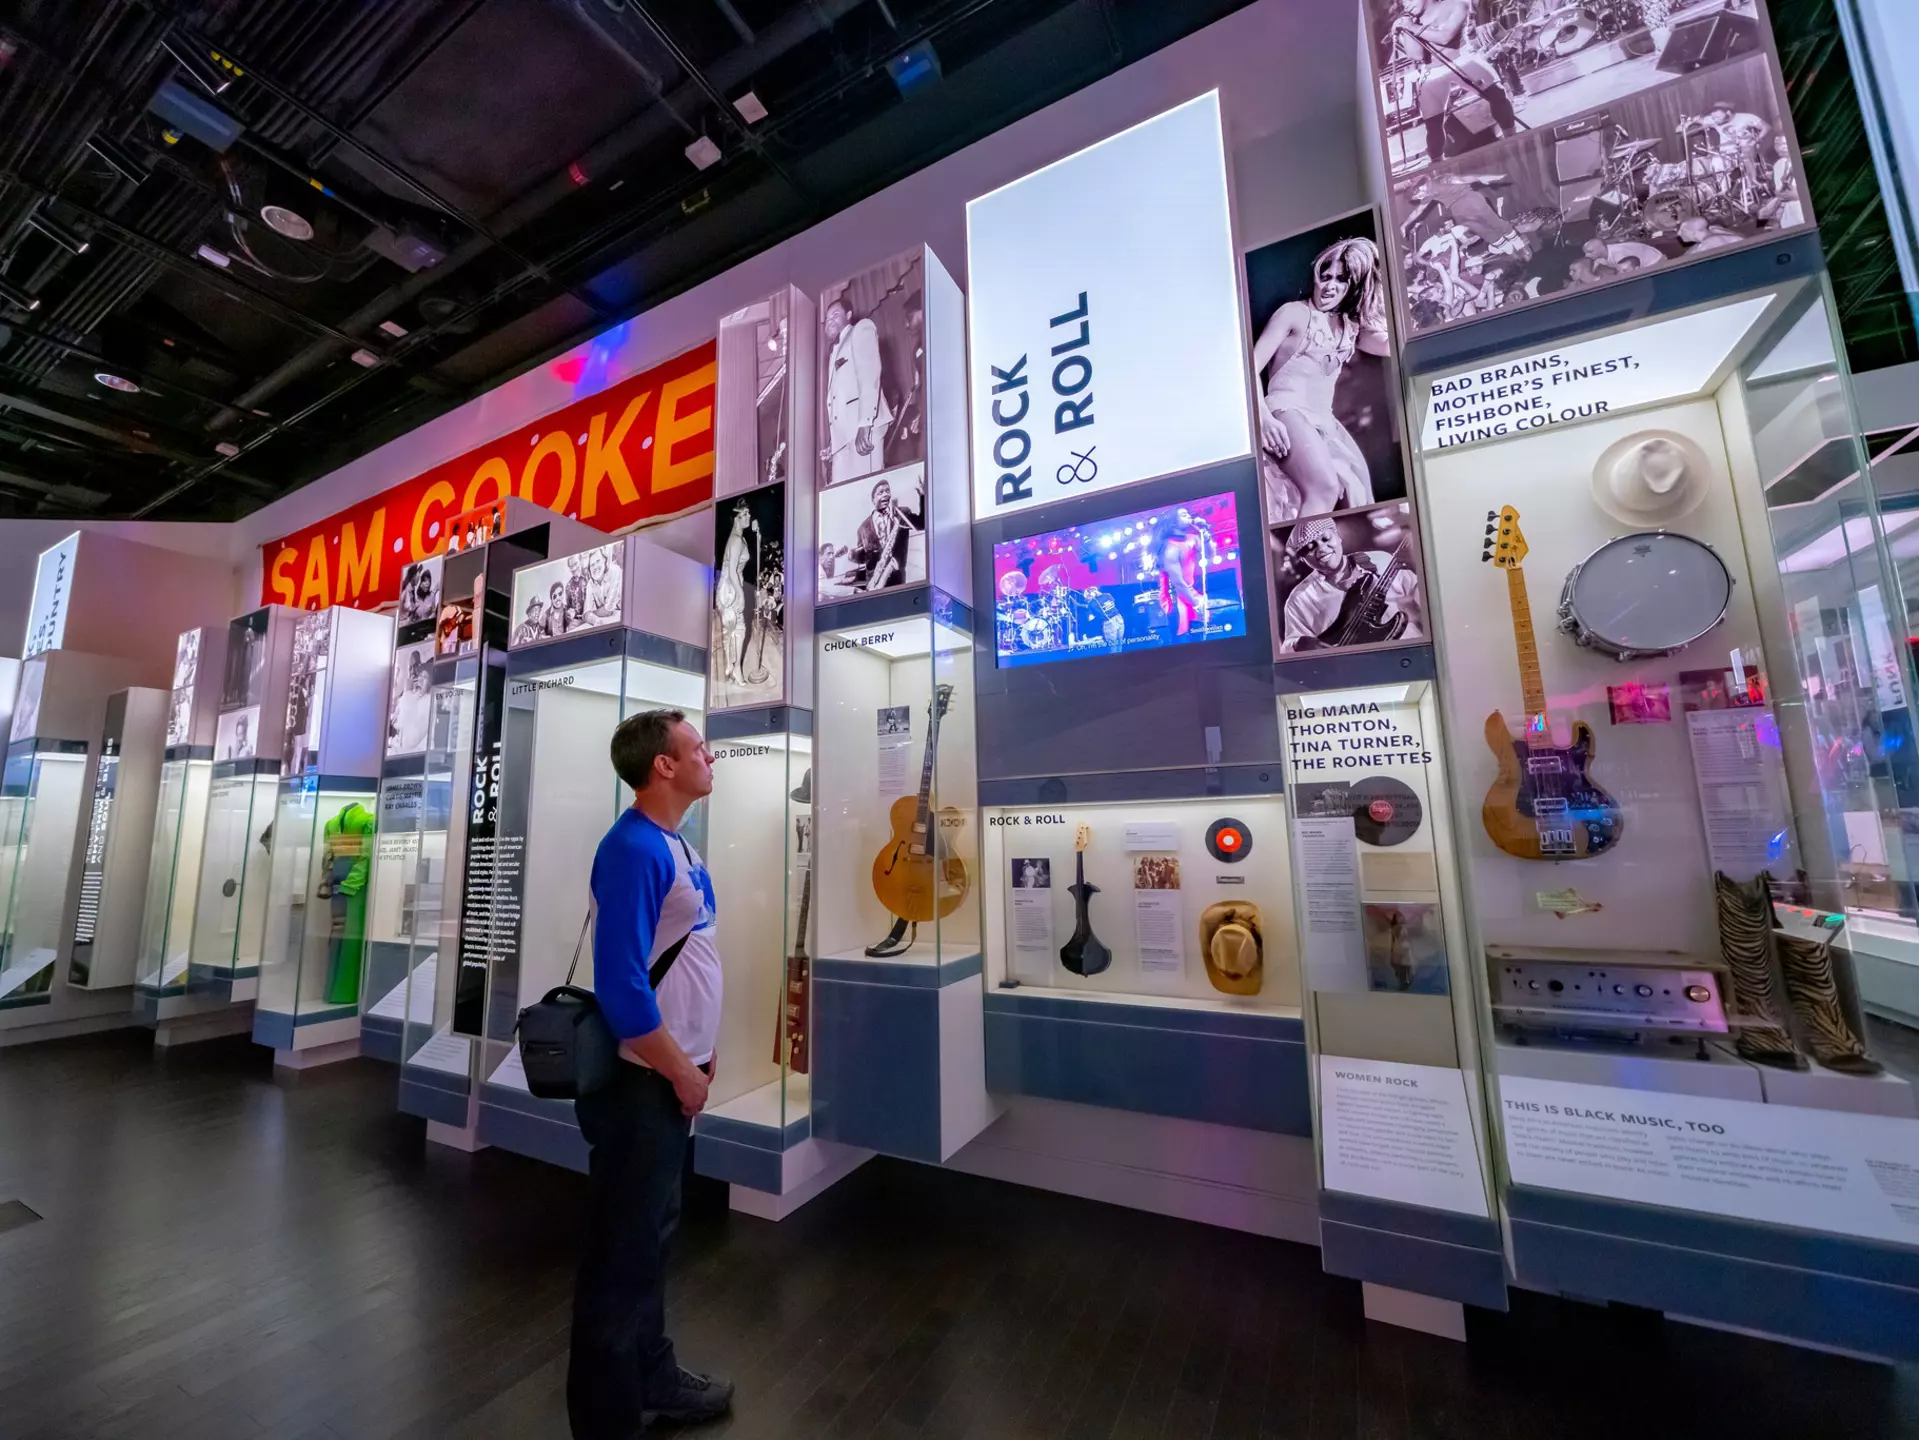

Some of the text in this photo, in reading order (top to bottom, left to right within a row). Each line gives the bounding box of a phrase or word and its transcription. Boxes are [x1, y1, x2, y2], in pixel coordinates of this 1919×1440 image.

[1050, 291, 1098, 485] & ROLL
[1431, 354, 1569, 397] BAD BRAINS,
[1434, 356, 1640, 414] MOTHER'S FINEST,
[990, 353, 1032, 506] ROCK
[1436, 396, 1551, 431] FISHBONE,
[1438, 400, 1609, 448] LIVING COLOUR
[271, 361, 716, 612] SAM COOKE
[46, 552, 66, 648] OUNTRY
[824, 632, 895, 652] CHUCK BERRY
[512, 676, 574, 695] LITTLE RICHARD
[1287, 702, 1380, 721] BIG MAMA
[1289, 718, 1397, 737] THORNTON,
[714, 746, 770, 760] BO DIDDLEY
[1290, 735, 1421, 754] TINA TURNER,
[1291, 751, 1433, 770] THE RONETTES
[472, 756, 488, 824] ROCK
[91, 801, 104, 864] RHYTHM
[989, 814, 1066, 826] ROCK & ROLL
[1335, 1071, 1419, 1088] WOMEN ROCK
[1504, 1100, 1725, 1135] THIS IS BLACK MUSIC, TOO
